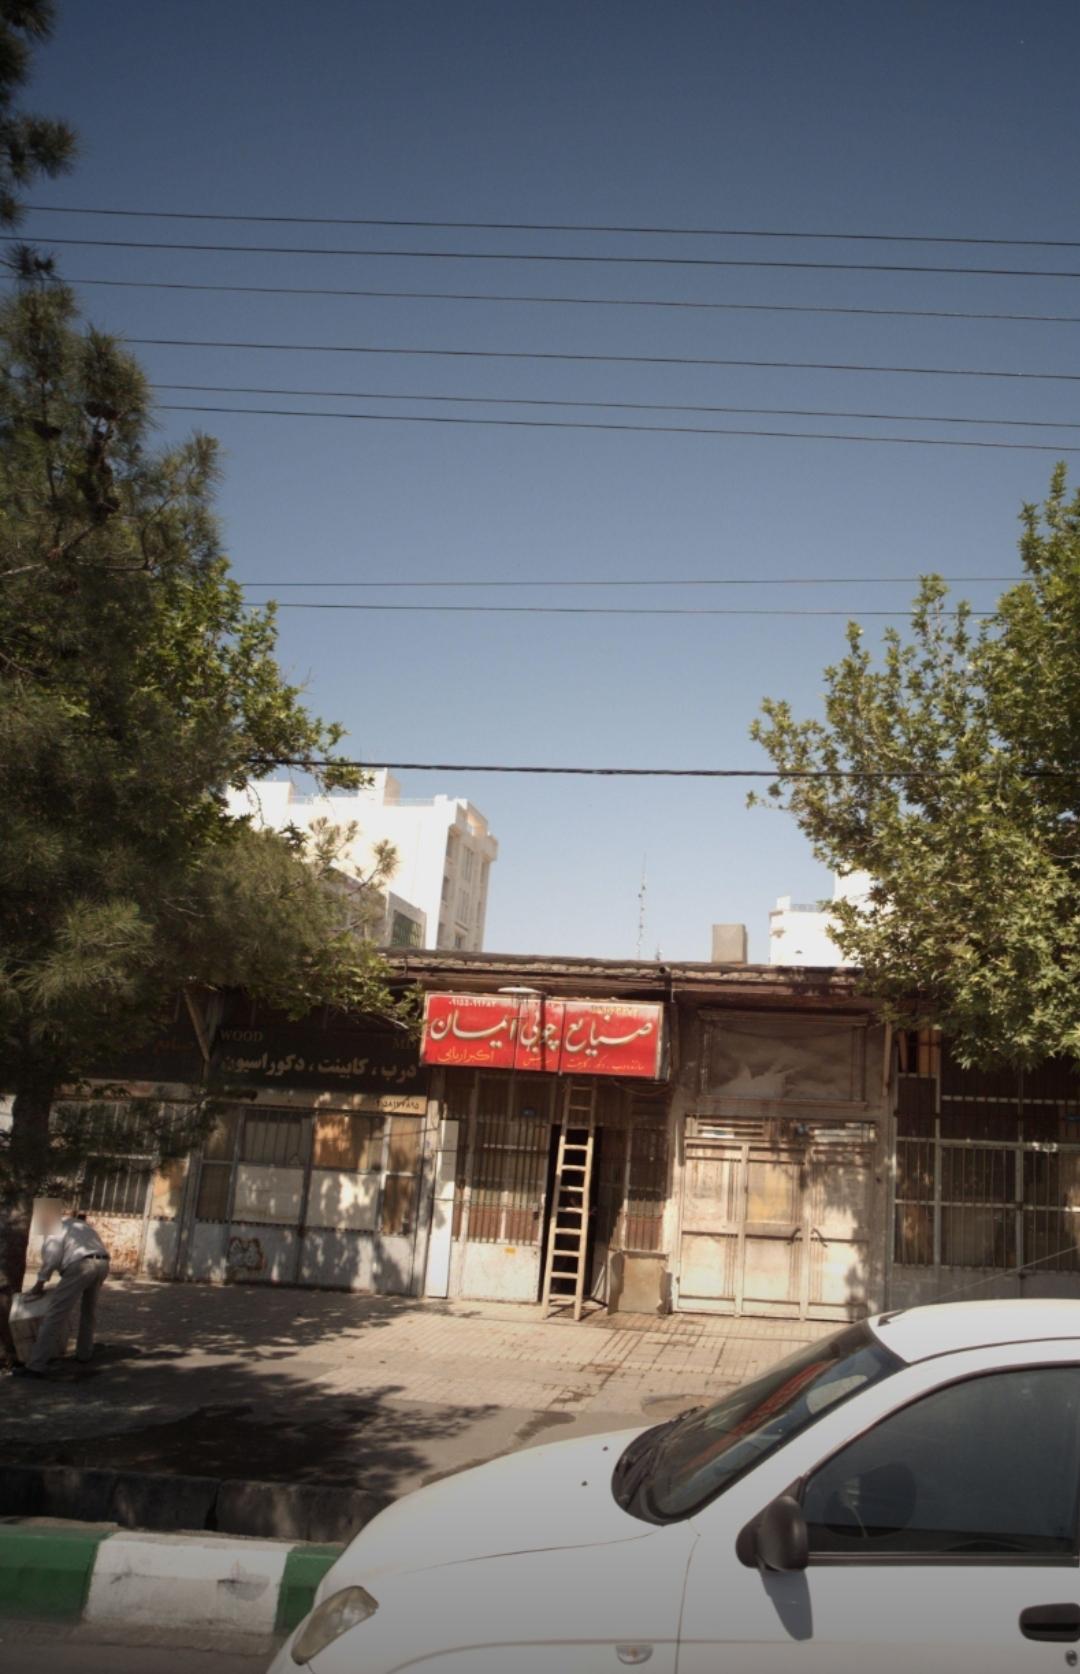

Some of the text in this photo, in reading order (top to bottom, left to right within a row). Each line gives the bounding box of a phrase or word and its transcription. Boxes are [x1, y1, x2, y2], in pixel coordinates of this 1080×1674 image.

[220, 1030, 417, 1049] WOOD MD
[430, 1008, 654, 1056] صنایع چوبی ایمان
[221, 1052, 305, 1077] دکوراسیون
[318, 1057, 369, 1079] کابینت
[381, 1063, 417, 1084] درب
